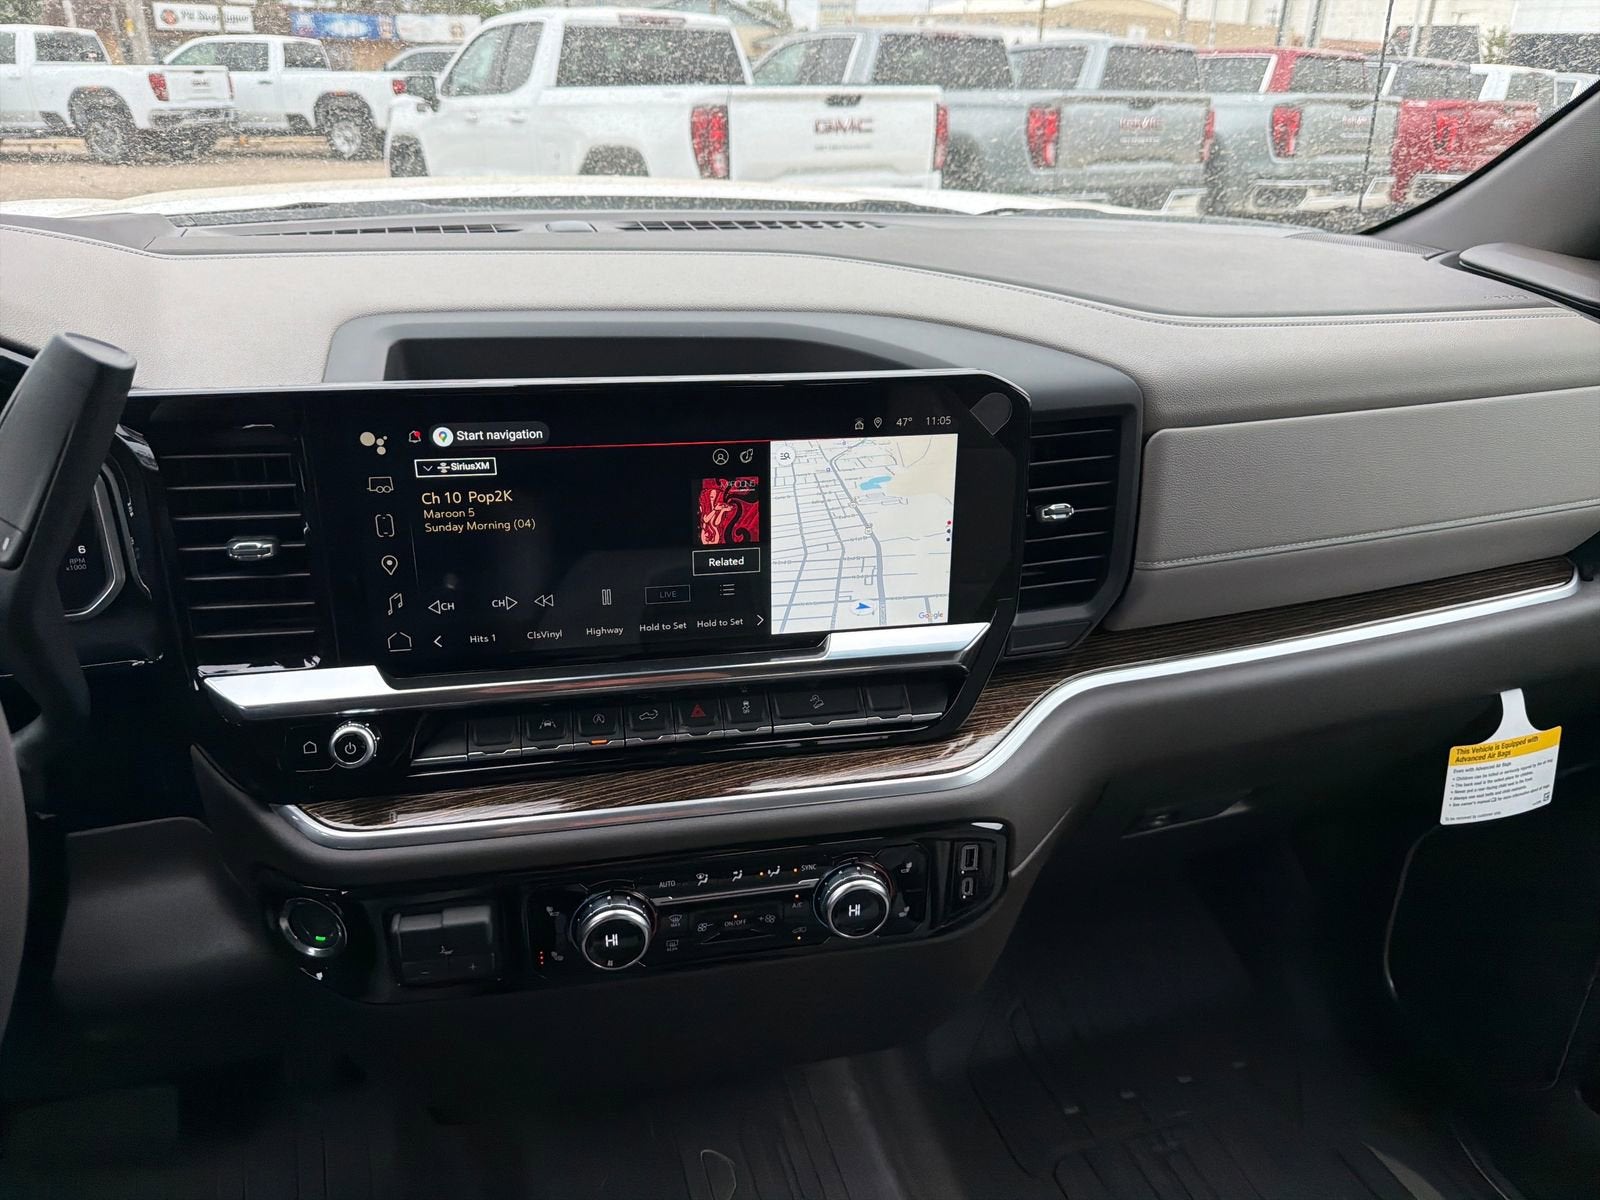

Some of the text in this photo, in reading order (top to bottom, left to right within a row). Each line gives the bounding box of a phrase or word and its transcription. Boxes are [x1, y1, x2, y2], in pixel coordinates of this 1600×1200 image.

[814, 118, 874, 134] GMC
[926, 415, 952, 426] 11:05
[456, 429, 543, 442] Start navigation
[450, 461, 490, 471] SiriusXM
[421, 489, 513, 505] Ch 10 Pop2K
[423, 507, 475, 519] Maroon 5
[424, 518, 536, 534] Sunday Morning (04)
[78, 545, 86, 554] 6
[708, 556, 745, 567] Related
[659, 591, 677, 599] LIVE
[440, 602, 455, 611] CH
[491, 599, 506, 608] CH
[918, 611, 944, 620] Google
[639, 624, 660, 632] Hold
[673, 621, 687, 630] Set
[696, 618, 744, 629] Hold to Set
[586, 627, 624, 638] Highway
[469, 634, 496, 644] Hits 1
[1472, 745, 1494, 754] Vehicle
[1501, 738, 1527, 749] Equipped
[1528, 735, 1539, 743] with
[1455, 750, 1511, 763] Advanced Air Bags
[801, 864, 817, 872] SYNC
[659, 880, 676, 889] AUTO
[848, 903, 861, 917] HI
[724, 919, 747, 928] ON/OFF
[605, 933, 619, 948] HI
